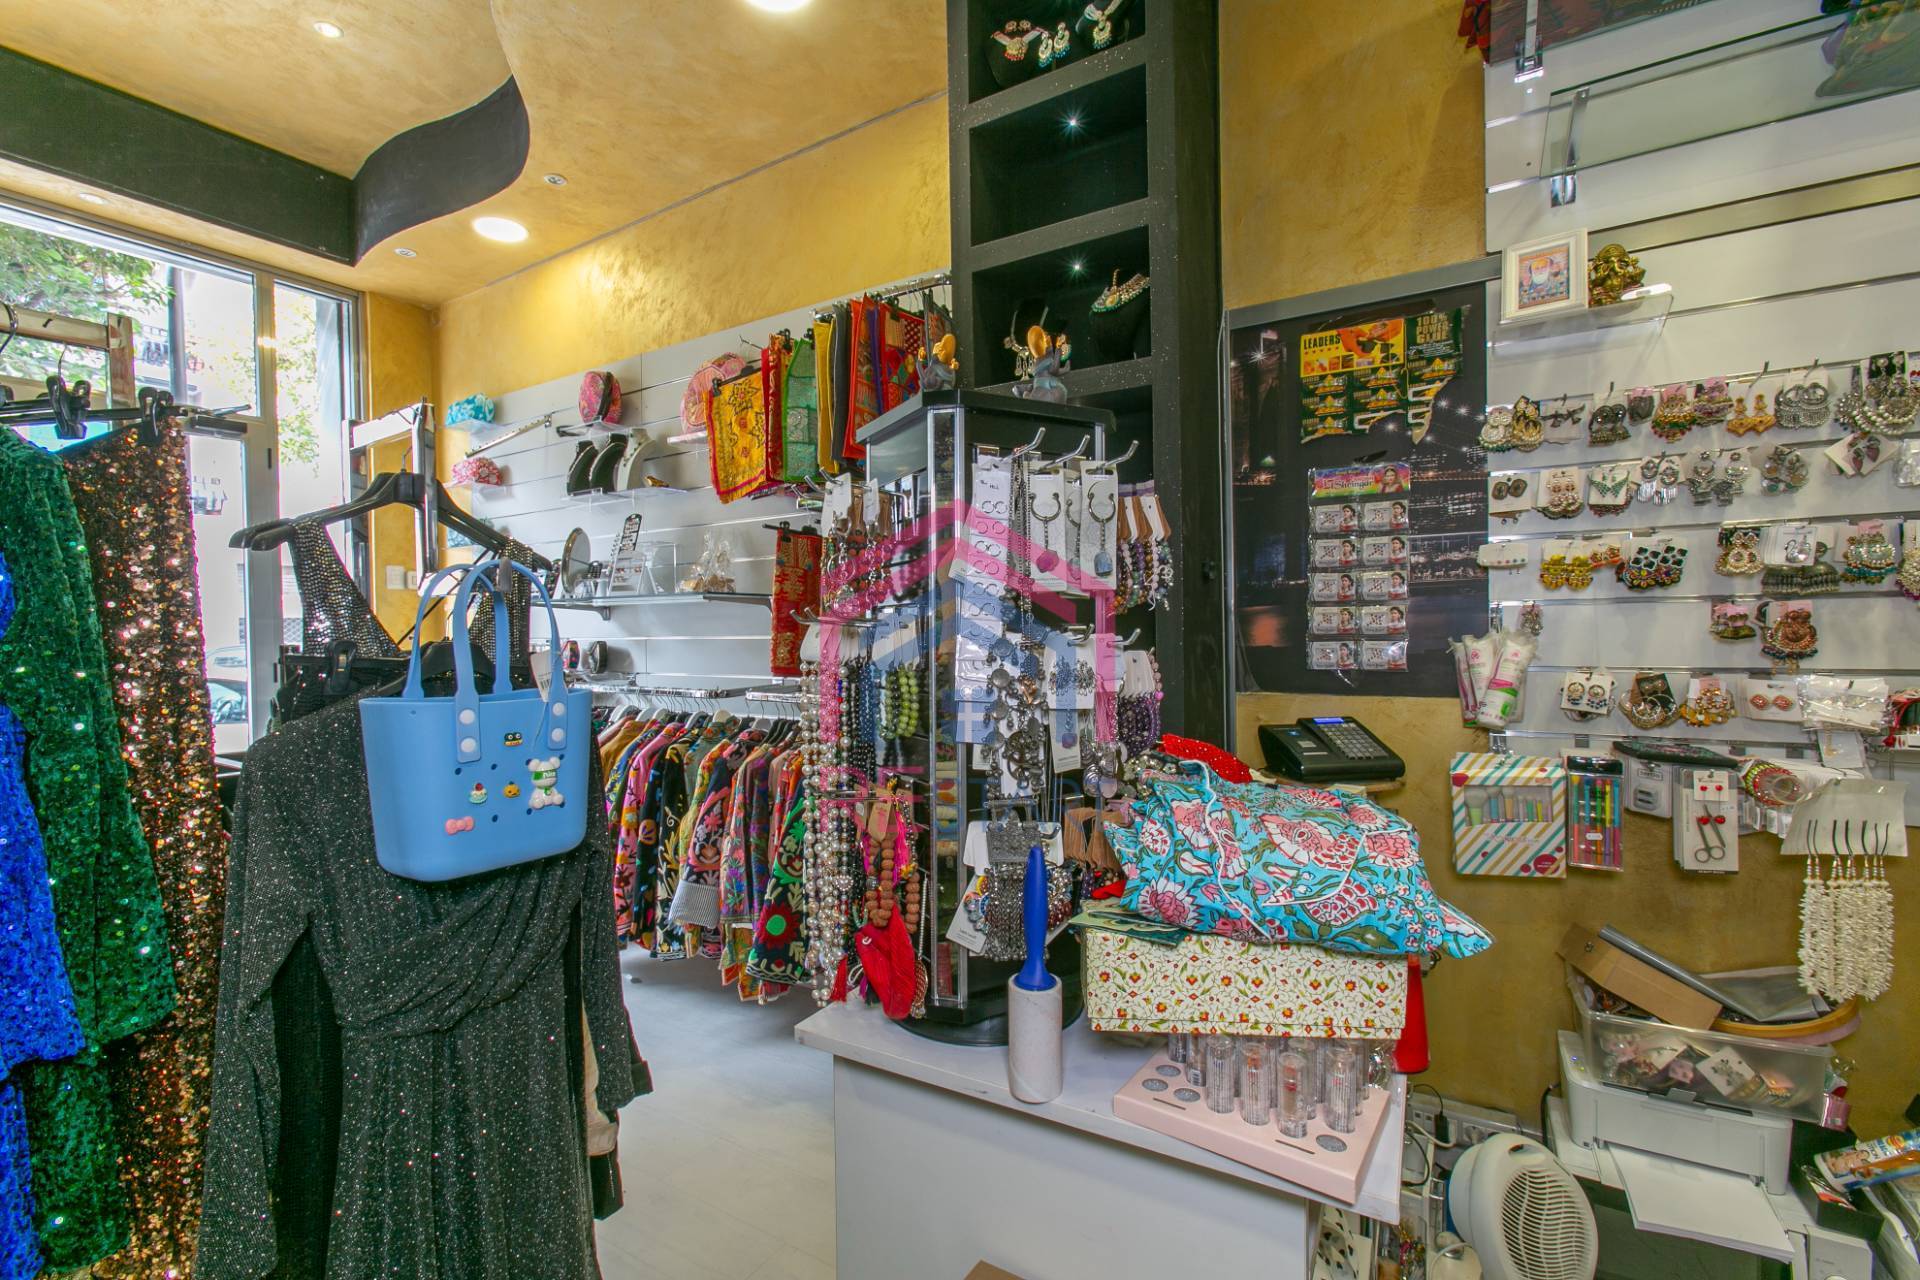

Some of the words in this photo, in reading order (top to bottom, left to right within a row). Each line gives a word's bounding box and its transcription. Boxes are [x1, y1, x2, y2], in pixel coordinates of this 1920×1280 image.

[1416, 313, 1448, 326] 100%
[1416, 321, 1448, 334] POWER
[1304, 334, 1341, 349] LEADERS
[1416, 331, 1449, 344] GLUE
